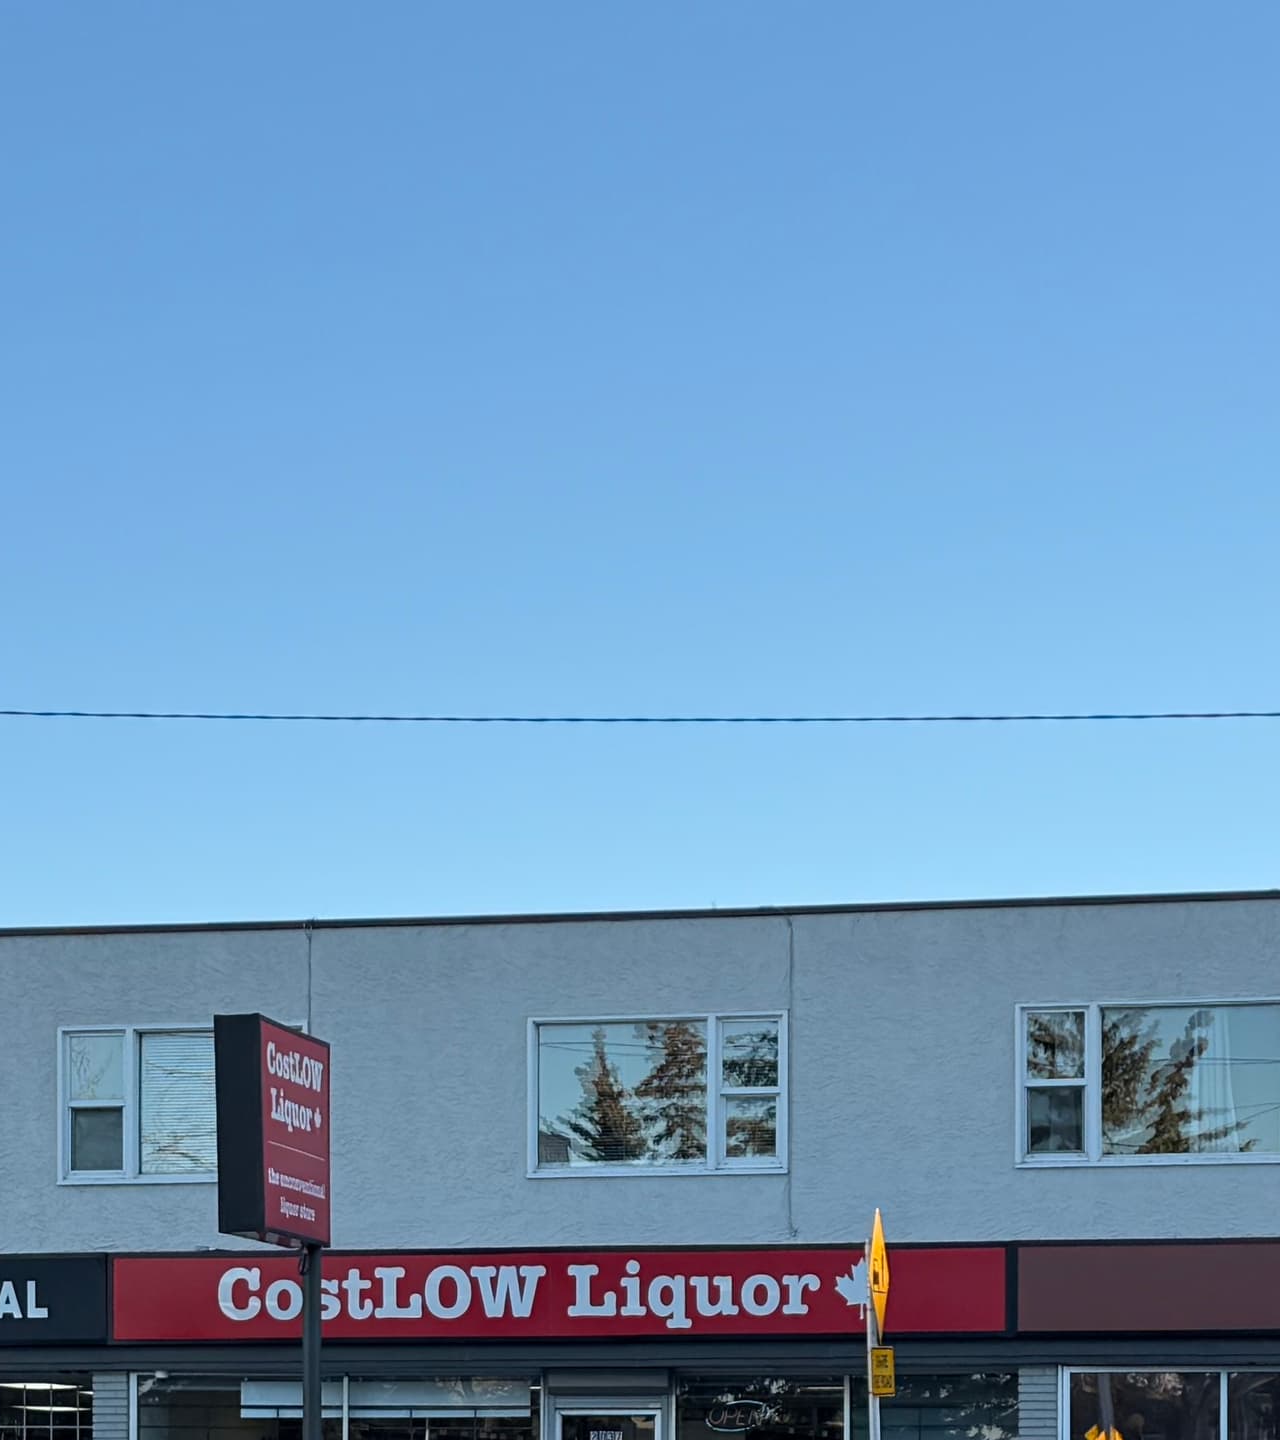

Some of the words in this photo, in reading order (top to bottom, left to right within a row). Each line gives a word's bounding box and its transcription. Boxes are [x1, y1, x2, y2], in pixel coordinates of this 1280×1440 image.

[266, 1041, 323, 1092] CostLOW
[270, 1087, 313, 1133] Liquor
[217, 1264, 546, 1321] CostLOW
[567, 1259, 821, 1329] Liquor
[708, 1407, 761, 1426] OPEN
